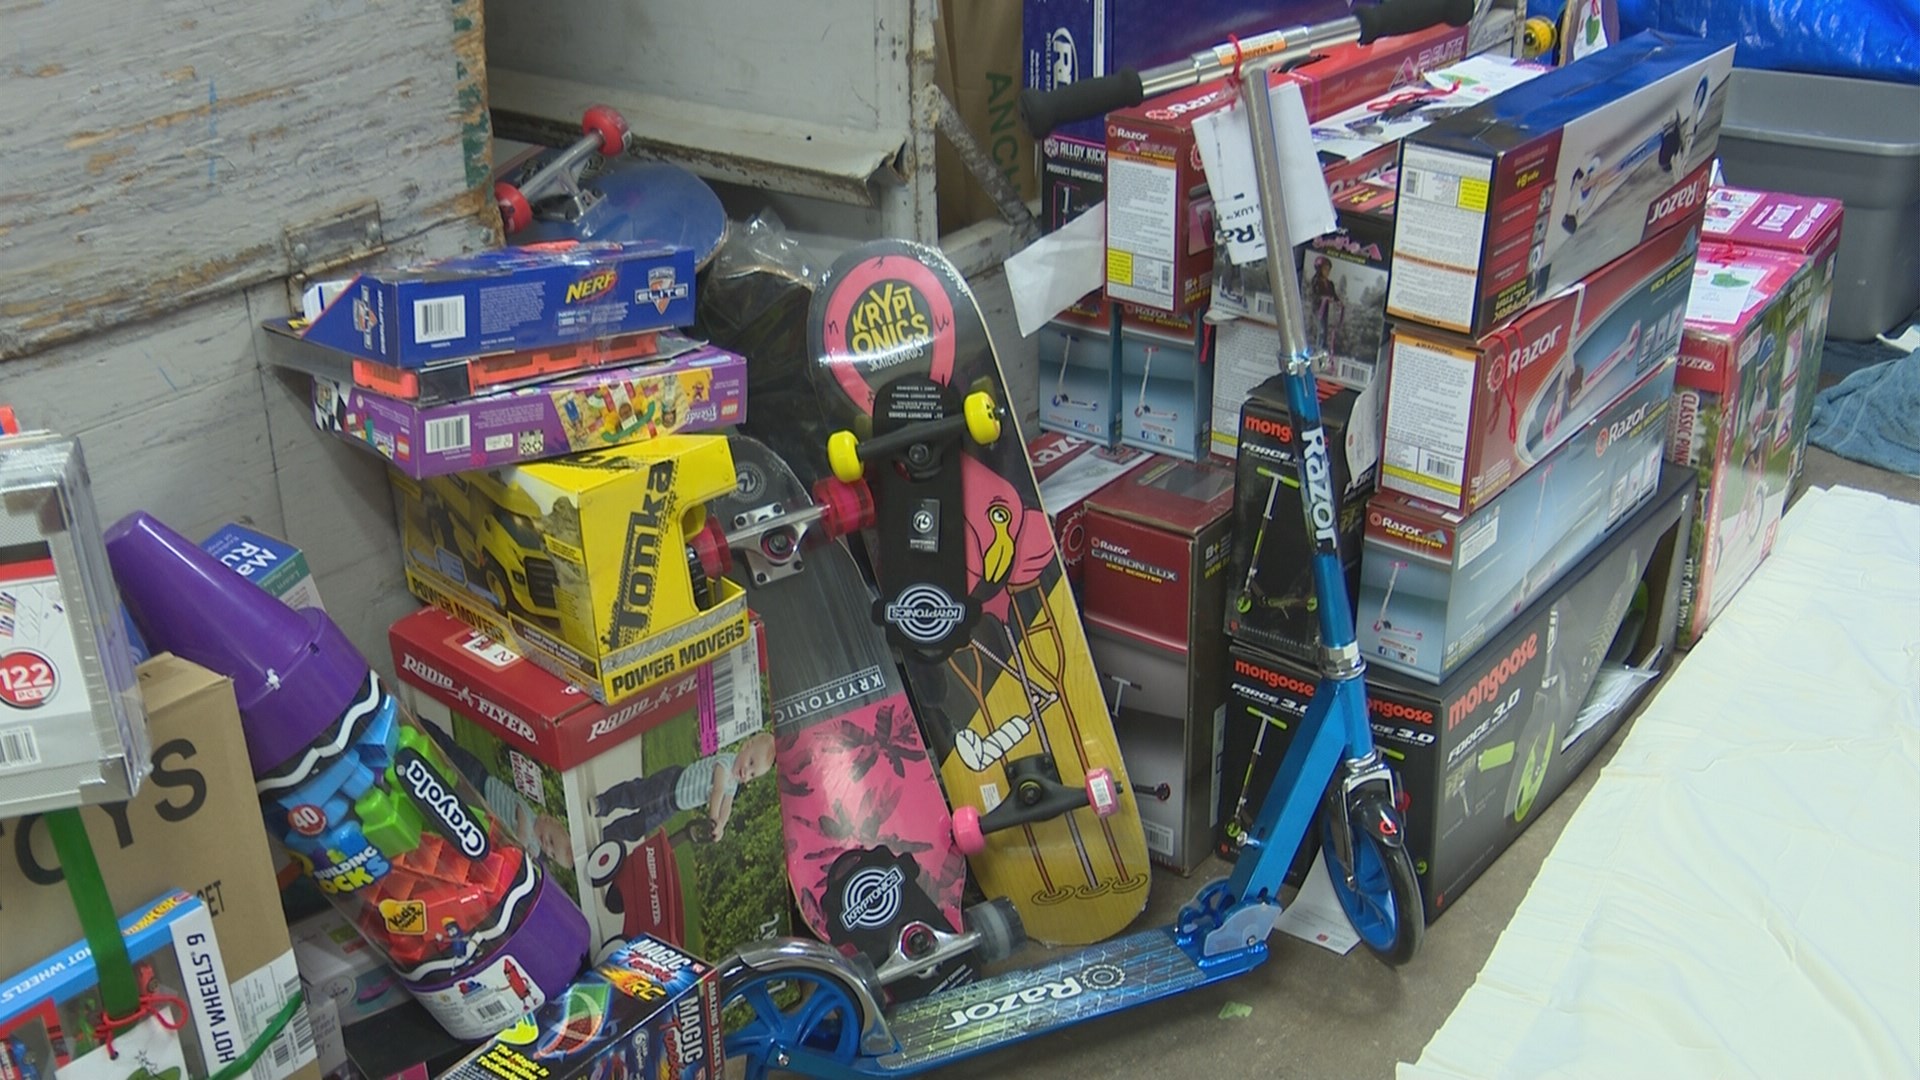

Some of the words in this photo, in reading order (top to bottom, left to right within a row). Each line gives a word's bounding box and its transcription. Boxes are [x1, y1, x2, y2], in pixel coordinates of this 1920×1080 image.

[1117, 127, 1148, 141] Razor
[1060, 142, 1085, 158] ALLOY
[1086, 147, 1106, 162] KICK
[1046, 163, 1070, 177] PRODUCT
[1647, 183, 1697, 225] Razor
[565, 270, 616, 304] NERF
[636, 284, 688, 303] ELITE
[852, 283, 917, 334] KRYPT
[1154, 317, 1190, 330] SCOOTER
[852, 313, 930, 356] ONICS
[1506, 324, 1563, 379] Razor
[867, 346, 925, 373] SKATEBOARDS
[1245, 415, 1293, 443] mong
[1608, 402, 1650, 447] Razor
[1677, 393, 1698, 436] CLASSIC
[1241, 442, 1291, 461] FORCE
[1301, 426, 1337, 549] Razor
[1382, 516, 1423, 536] Razor
[1405, 533, 1443, 549] SCOOTER
[617, 458, 675, 631] Tonka
[1100, 540, 1130, 556] Razor
[236, 548, 278, 577] Ma
[1091, 547, 1146, 573] CARBON
[1149, 565, 1178, 581] LUX
[1125, 566, 1163, 585] SCOOTER
[889, 605, 962, 620] KRYPTONICS
[611, 655, 676, 695] POWER
[678, 620, 746, 667] MOVERS
[0, 663, 52, 690] 122
[1231, 682, 1279, 703] FORCE
[1234, 659, 1315, 698] mongoose
[1449, 632, 1538, 732] mongoose
[401, 652, 455, 690] RADIO
[476, 696, 538, 744] FLYER
[774, 671, 883, 723] KRYPTONIC
[1366, 697, 1434, 725] ongoose
[587, 698, 651, 743] RADIO
[1396, 725, 1436, 747] 3.0
[1447, 718, 1491, 764] FORCE
[1491, 687, 1521, 724] 3.0
[291, 806, 318, 828] 40
[405, 757, 487, 858] Crayola
[844, 870, 901, 926] KRYPTONICS
[630, 938, 692, 971] MAGIC
[1, 962, 67, 1000] WHEELS
[192, 951, 228, 1028] WHEELS
[631, 979, 667, 1001] RC
[707, 980, 718, 1027] AMAZING
[943, 976, 1083, 1030] Razor
[216, 1030, 236, 1064] HOT
[634, 1032, 647, 1046] 6
[678, 996, 705, 1064] MAGIC
[711, 1028, 723, 1068] TRACKS
